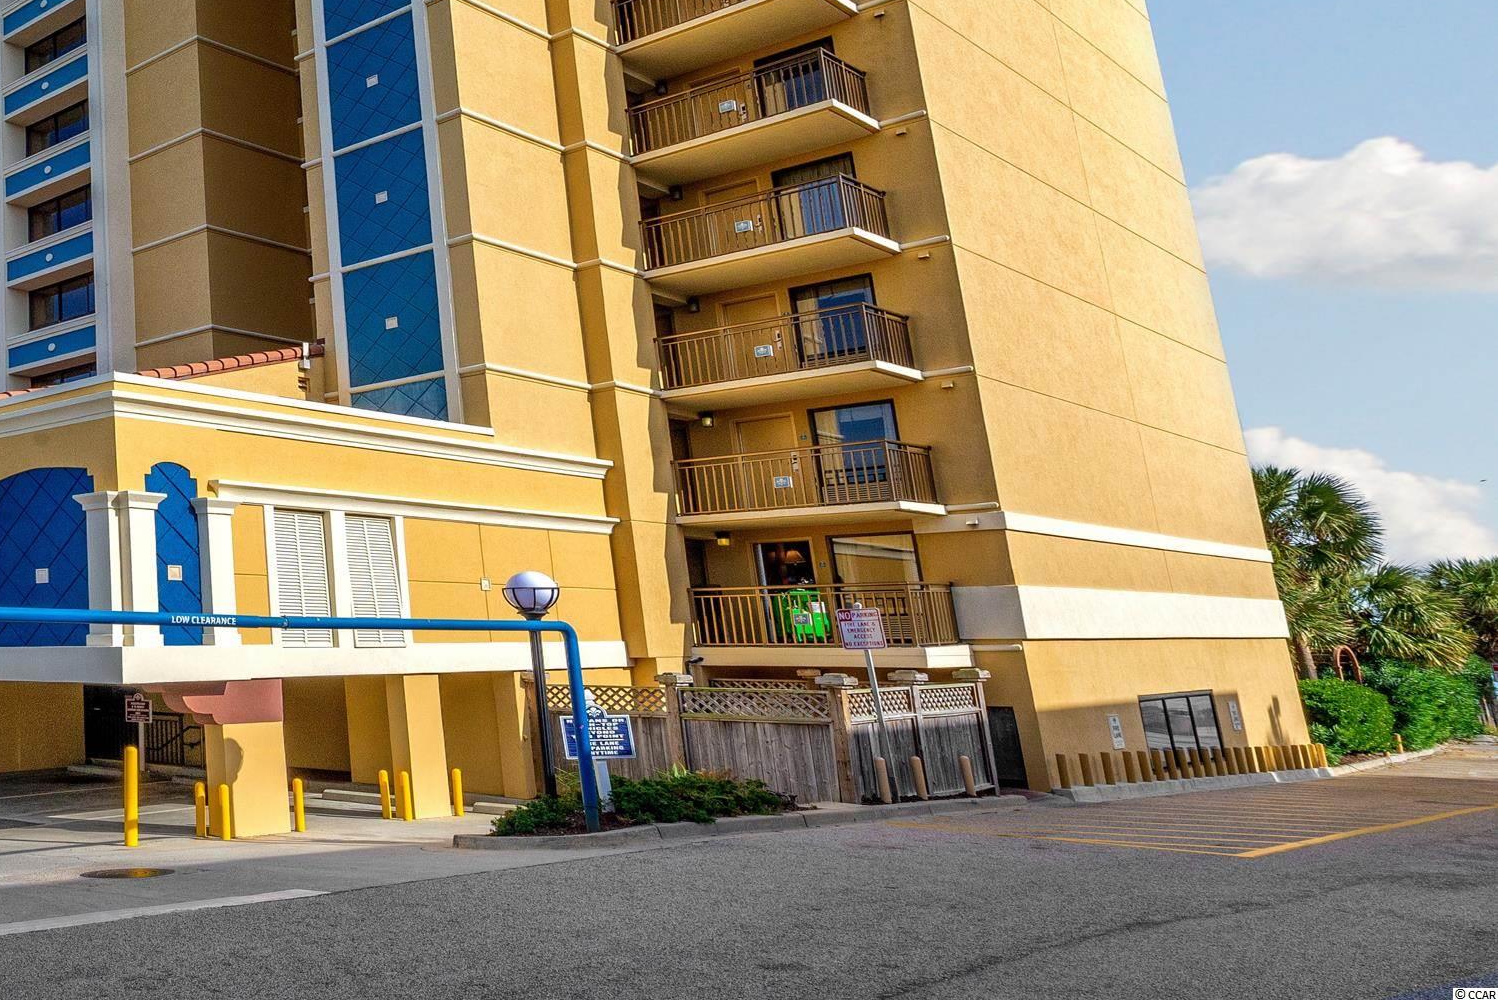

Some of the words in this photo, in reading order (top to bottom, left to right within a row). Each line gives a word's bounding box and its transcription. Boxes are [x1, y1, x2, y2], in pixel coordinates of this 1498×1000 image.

[171, 615, 189, 623] LOW
[191, 616, 236, 625] CLEARANCE
[839, 612, 850, 620] NO
